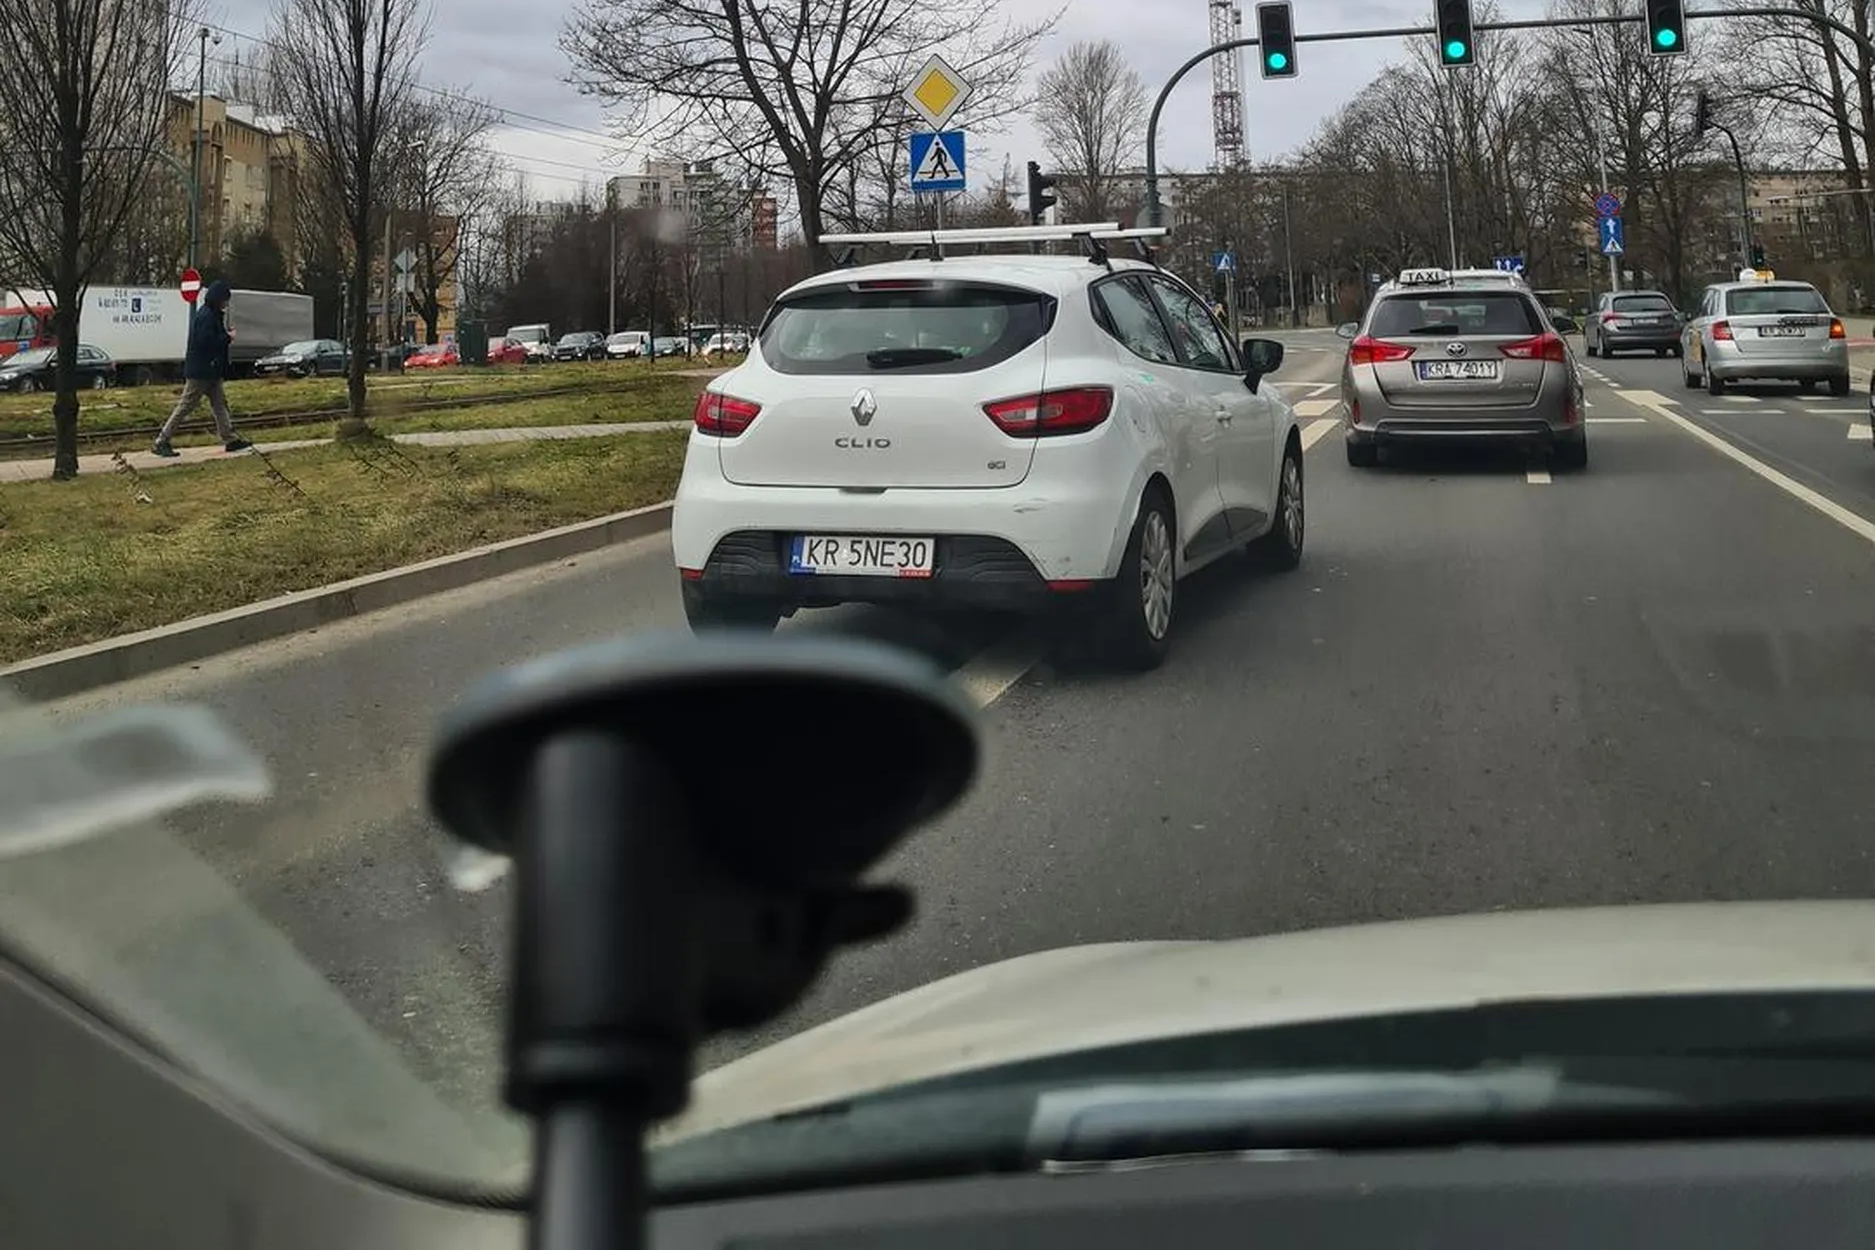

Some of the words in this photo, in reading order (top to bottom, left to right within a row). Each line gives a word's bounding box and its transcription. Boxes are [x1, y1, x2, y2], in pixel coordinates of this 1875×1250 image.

[1407, 272, 1439, 282] TAXI
[1428, 361, 1452, 376] KRA
[834, 438, 891, 449] CLIO
[807, 538, 839, 566] KR
[848, 540, 927, 568] 5NE30
